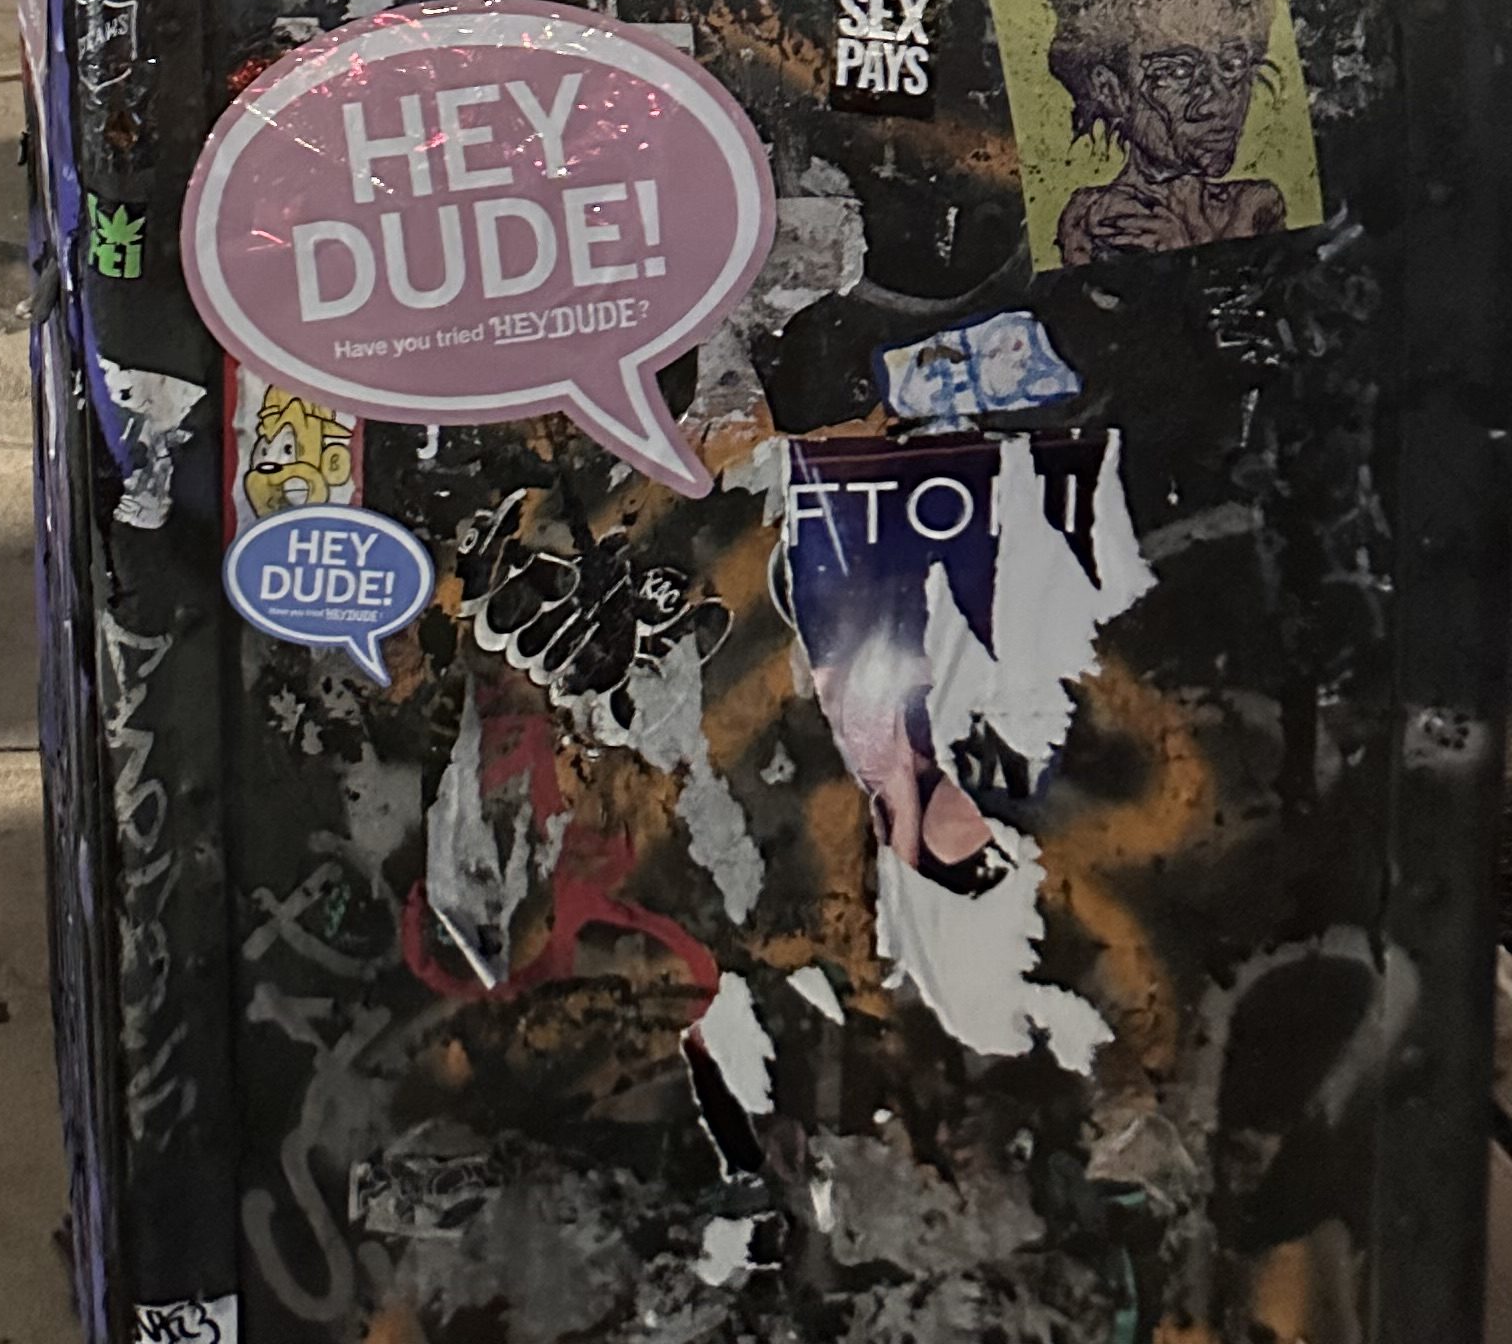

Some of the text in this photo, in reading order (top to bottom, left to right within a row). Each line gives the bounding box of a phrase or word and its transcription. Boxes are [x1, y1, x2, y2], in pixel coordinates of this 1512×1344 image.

[835, 37, 930, 96] PAYS
[341, 72, 584, 204] HEY
[291, 179, 667, 322] DUDE!
[333, 338, 388, 360] Have
[393, 335, 432, 358] you
[435, 324, 485, 348] tried
[287, 528, 380, 568] HEY
[259, 564, 396, 607] DUDE!
